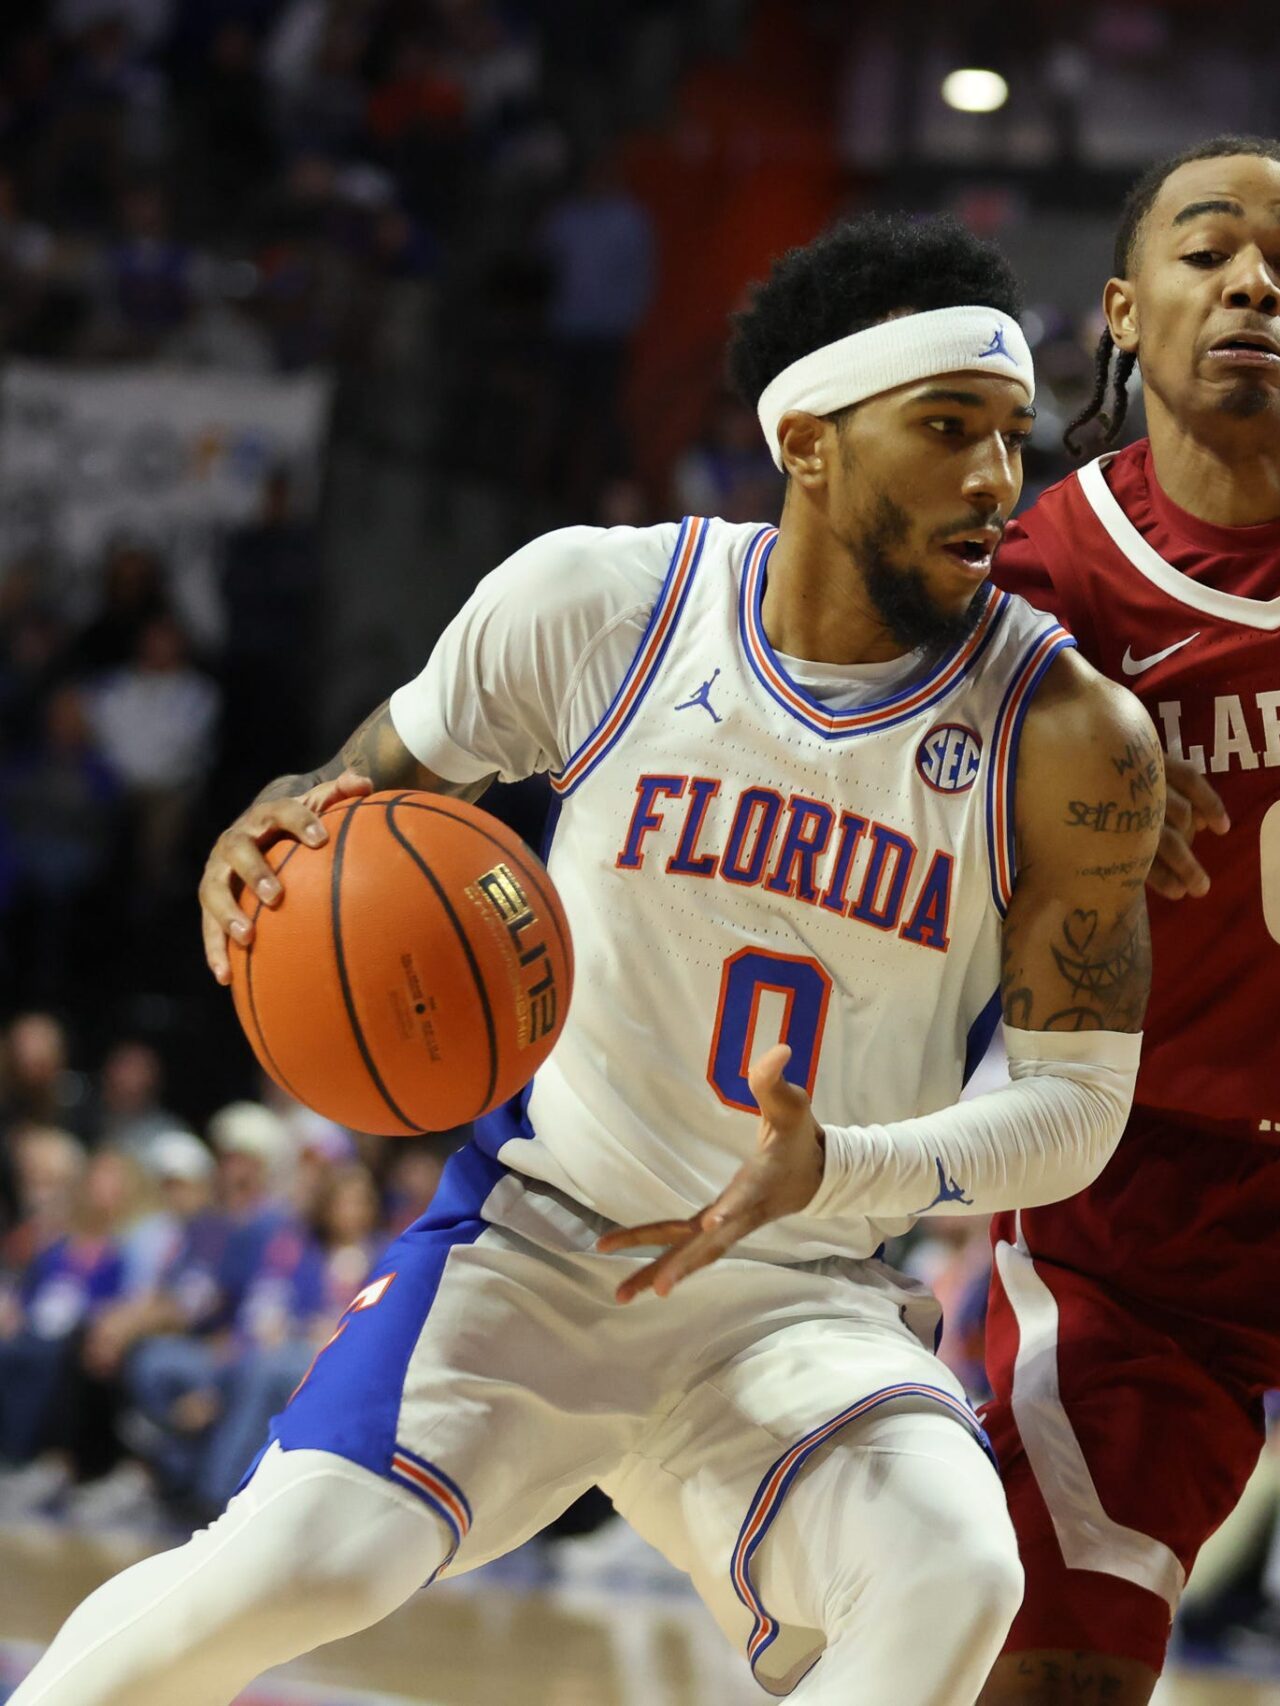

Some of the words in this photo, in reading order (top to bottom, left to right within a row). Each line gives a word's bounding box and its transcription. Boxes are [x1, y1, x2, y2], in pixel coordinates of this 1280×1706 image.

[922, 728, 980, 789] SEC
[615, 774, 955, 953] FLORIDA
[477, 863, 557, 1044] ELITE
[706, 945, 833, 1116] 0
